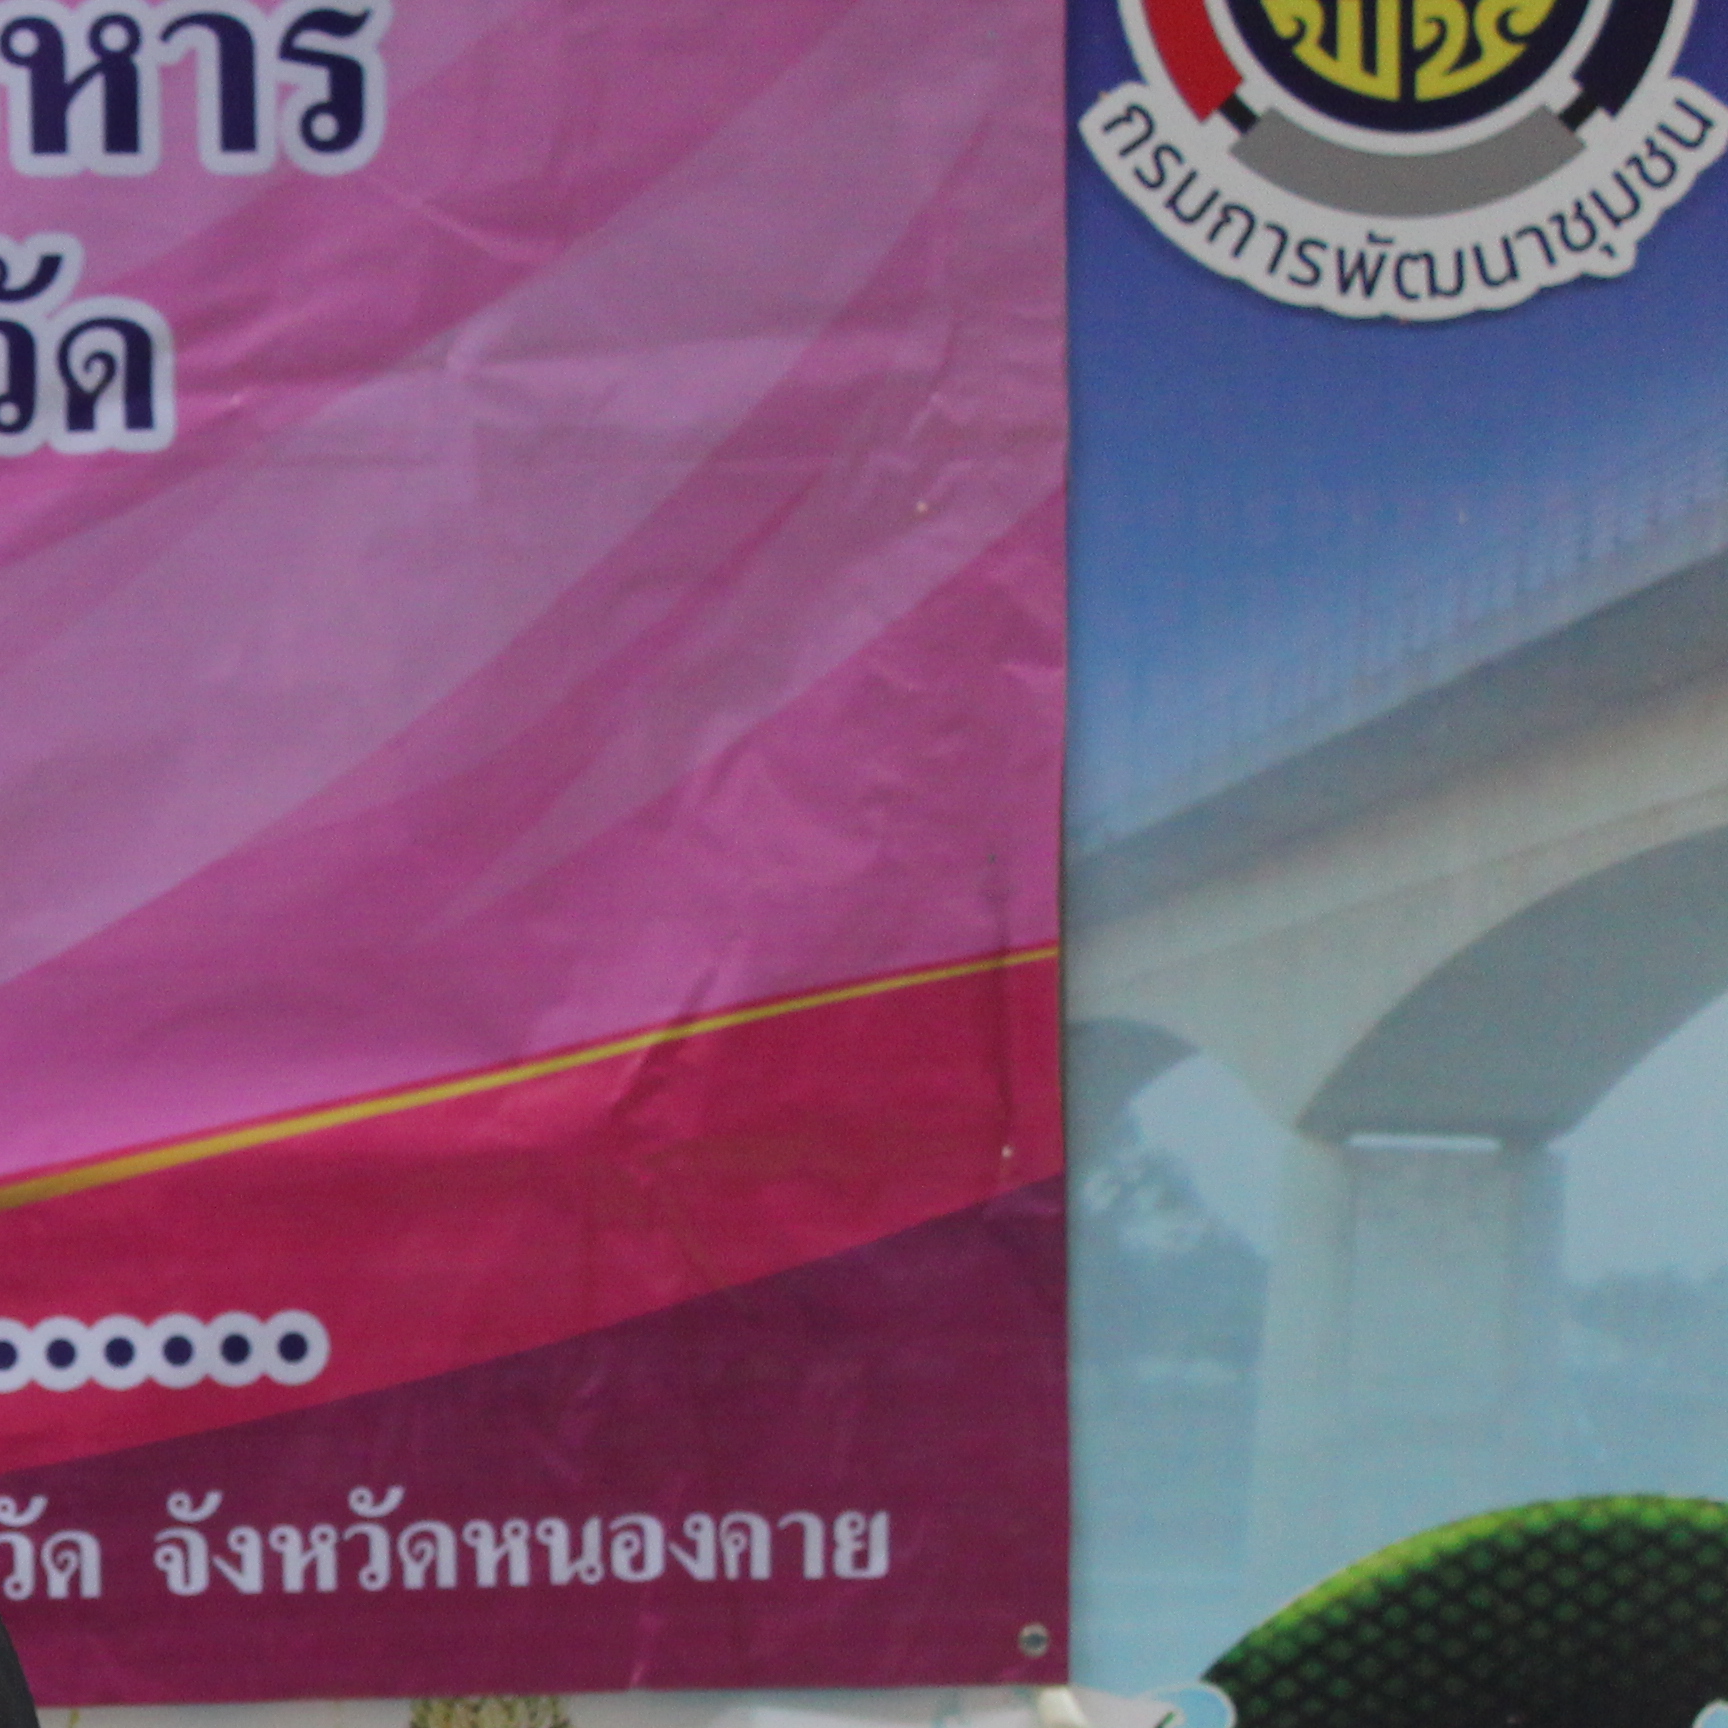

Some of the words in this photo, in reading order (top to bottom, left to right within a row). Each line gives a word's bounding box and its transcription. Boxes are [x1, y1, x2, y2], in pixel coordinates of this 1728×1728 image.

[1101, 97, 1716, 301] กรมการพัฒนาชุมชน
[152, 1486, 891, 1596] จังหวัดหนองคาย
